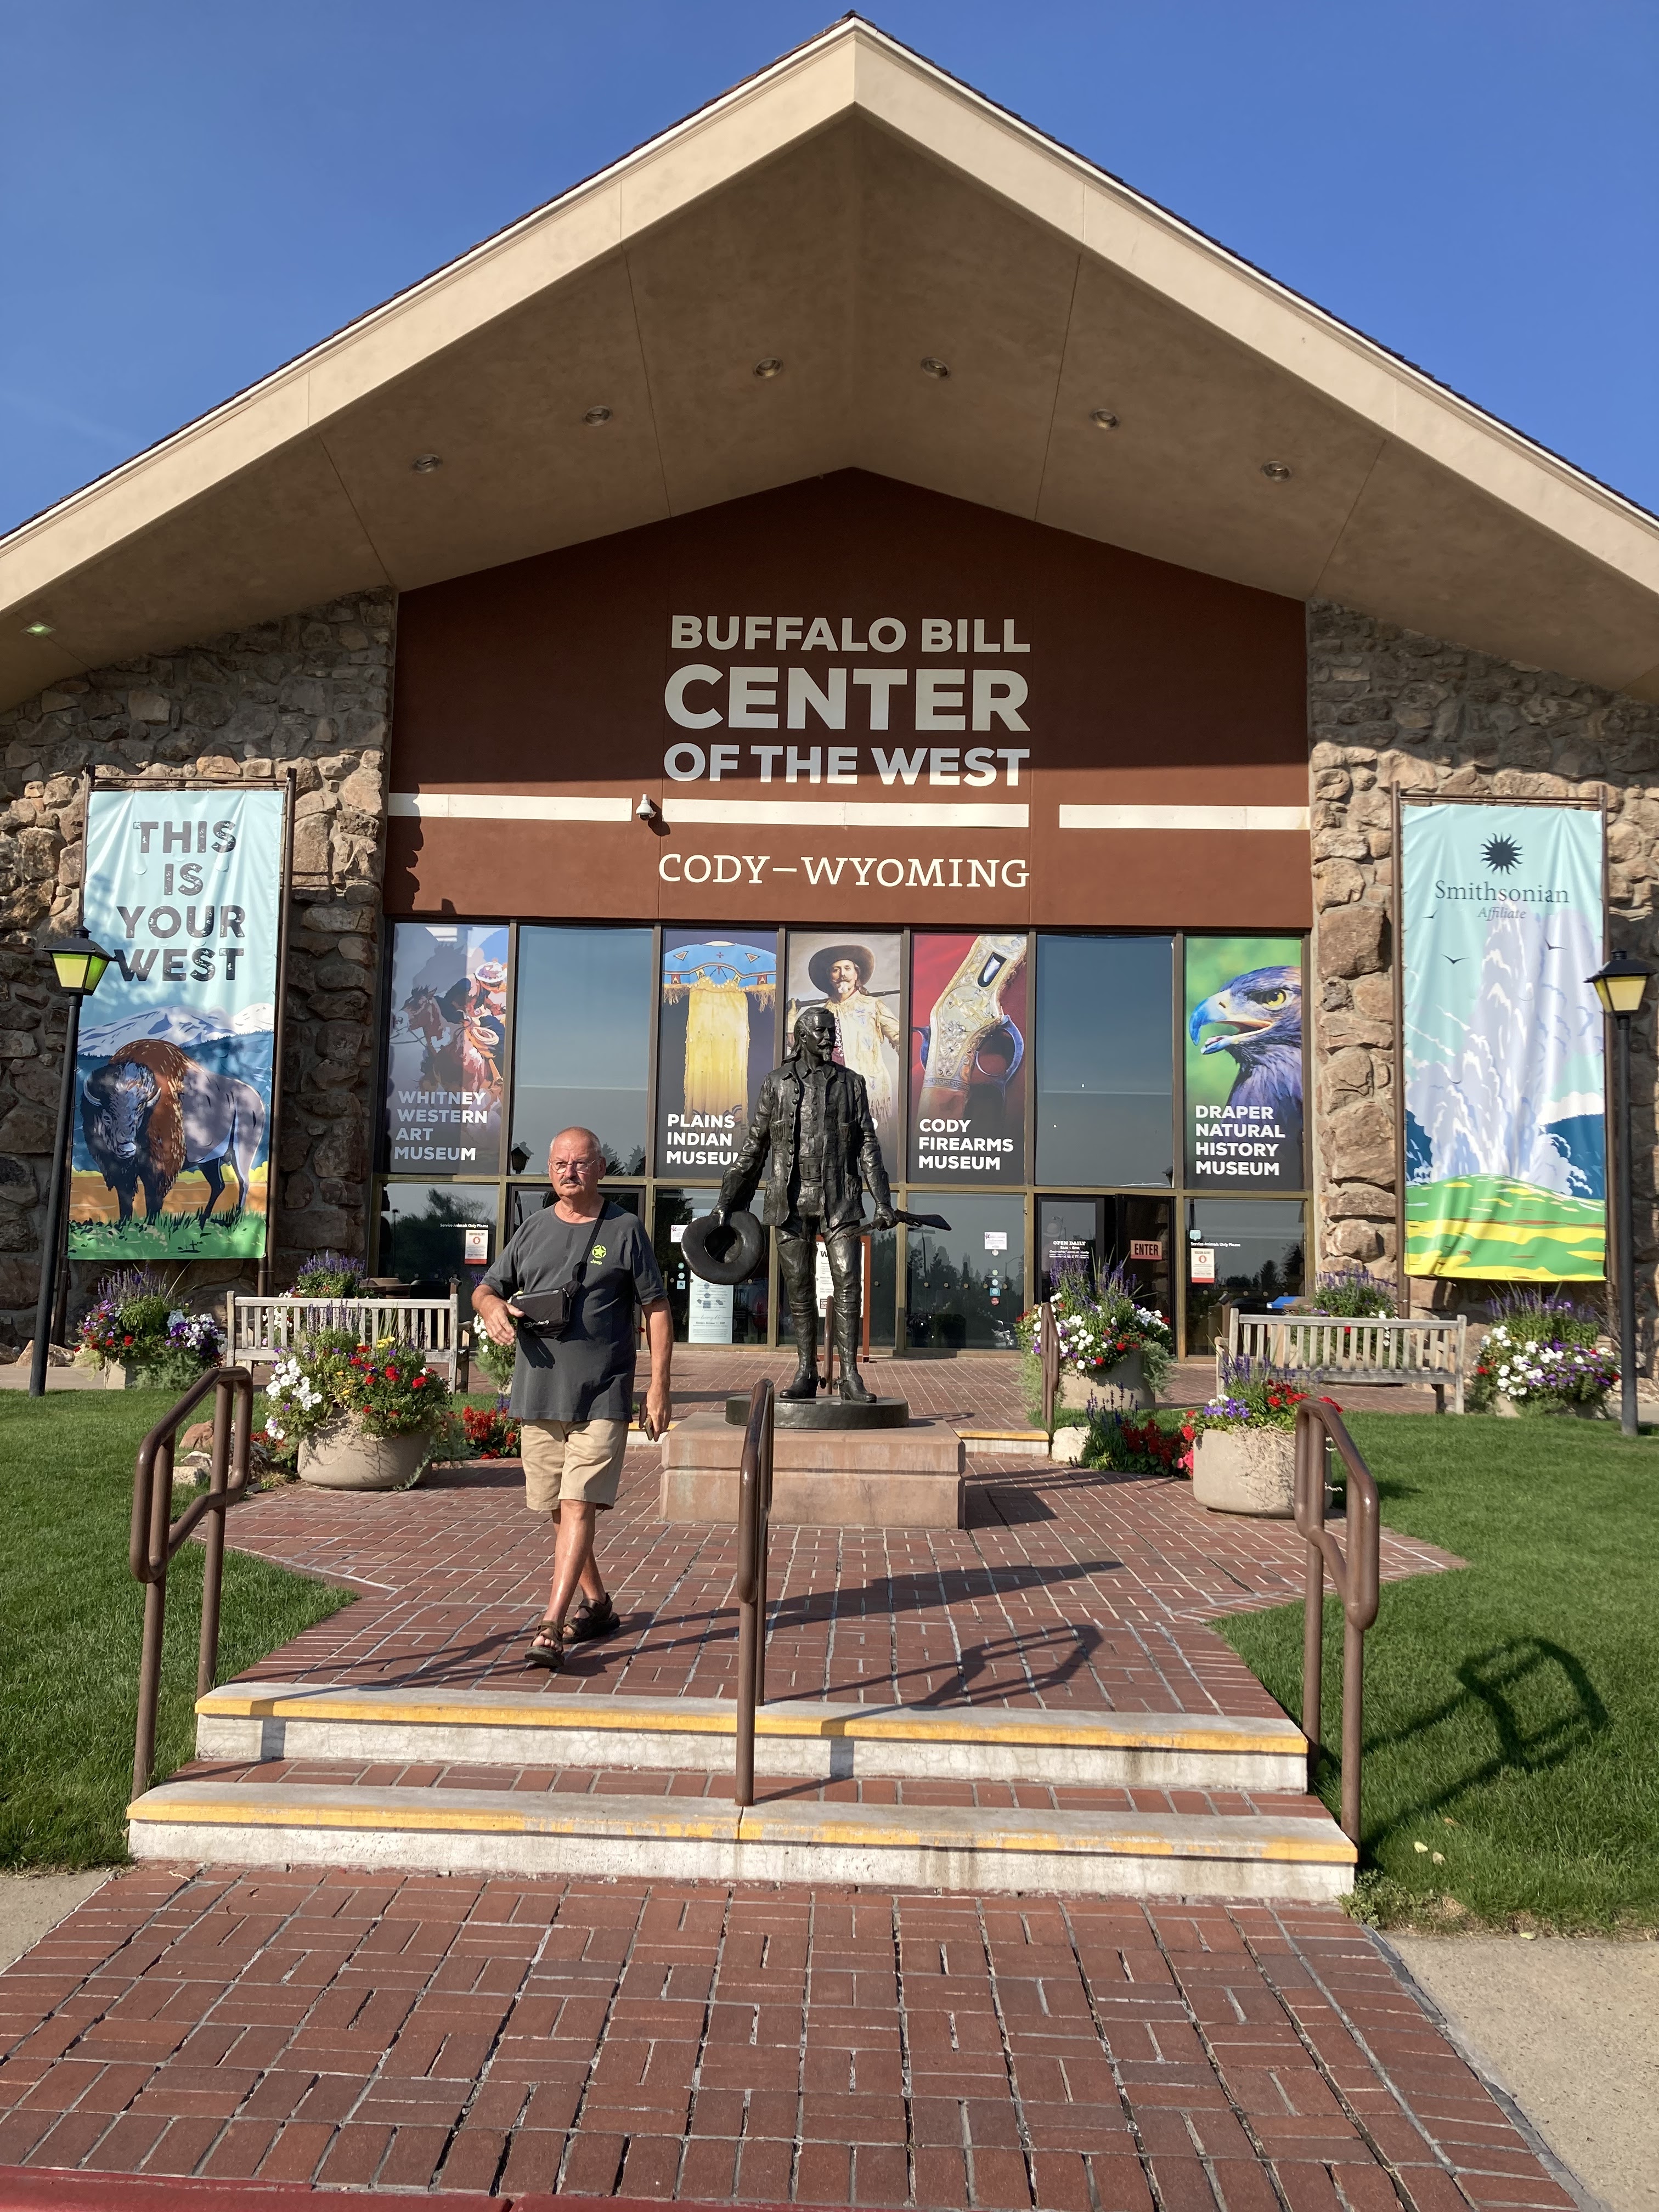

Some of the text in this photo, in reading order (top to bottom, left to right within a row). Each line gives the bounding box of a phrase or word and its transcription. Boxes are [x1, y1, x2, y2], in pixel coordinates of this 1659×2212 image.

[671, 614, 1030, 653] BUFFALO BILL
[664, 664, 1031, 731] CENTER
[664, 742, 1030, 787] OF THE WEST
[133, 820, 237, 854] THIS
[164, 862, 204, 896] IS
[1435, 879, 1570, 904] Smithsonian
[1477, 906, 1527, 920] Affiliate
[116, 905, 246, 939] YOUR
[114, 948, 245, 982] WEST
[398, 1090, 486, 1105] WHITNEY
[397, 1109, 488, 1124] WESTERN
[1195, 1105, 1274, 1120] DRAPER
[668, 1114, 735, 1128] PLAINS
[919, 1118, 972, 1132] CODY
[395, 1127, 434, 1141] ART
[1195, 1123, 1286, 1138] NATURAL
[667, 1132, 732, 1147] INDIAN
[919, 1137, 1014, 1152] FIREARMS
[394, 1147, 476, 1161] MUSEUM
[1195, 1142, 1279, 1157] HISTORY
[918, 1155, 1000, 1170] MUSEUM
[1196, 1160, 1279, 1176] MUSEUM
[1134, 1243, 1159, 1256] ENTER
